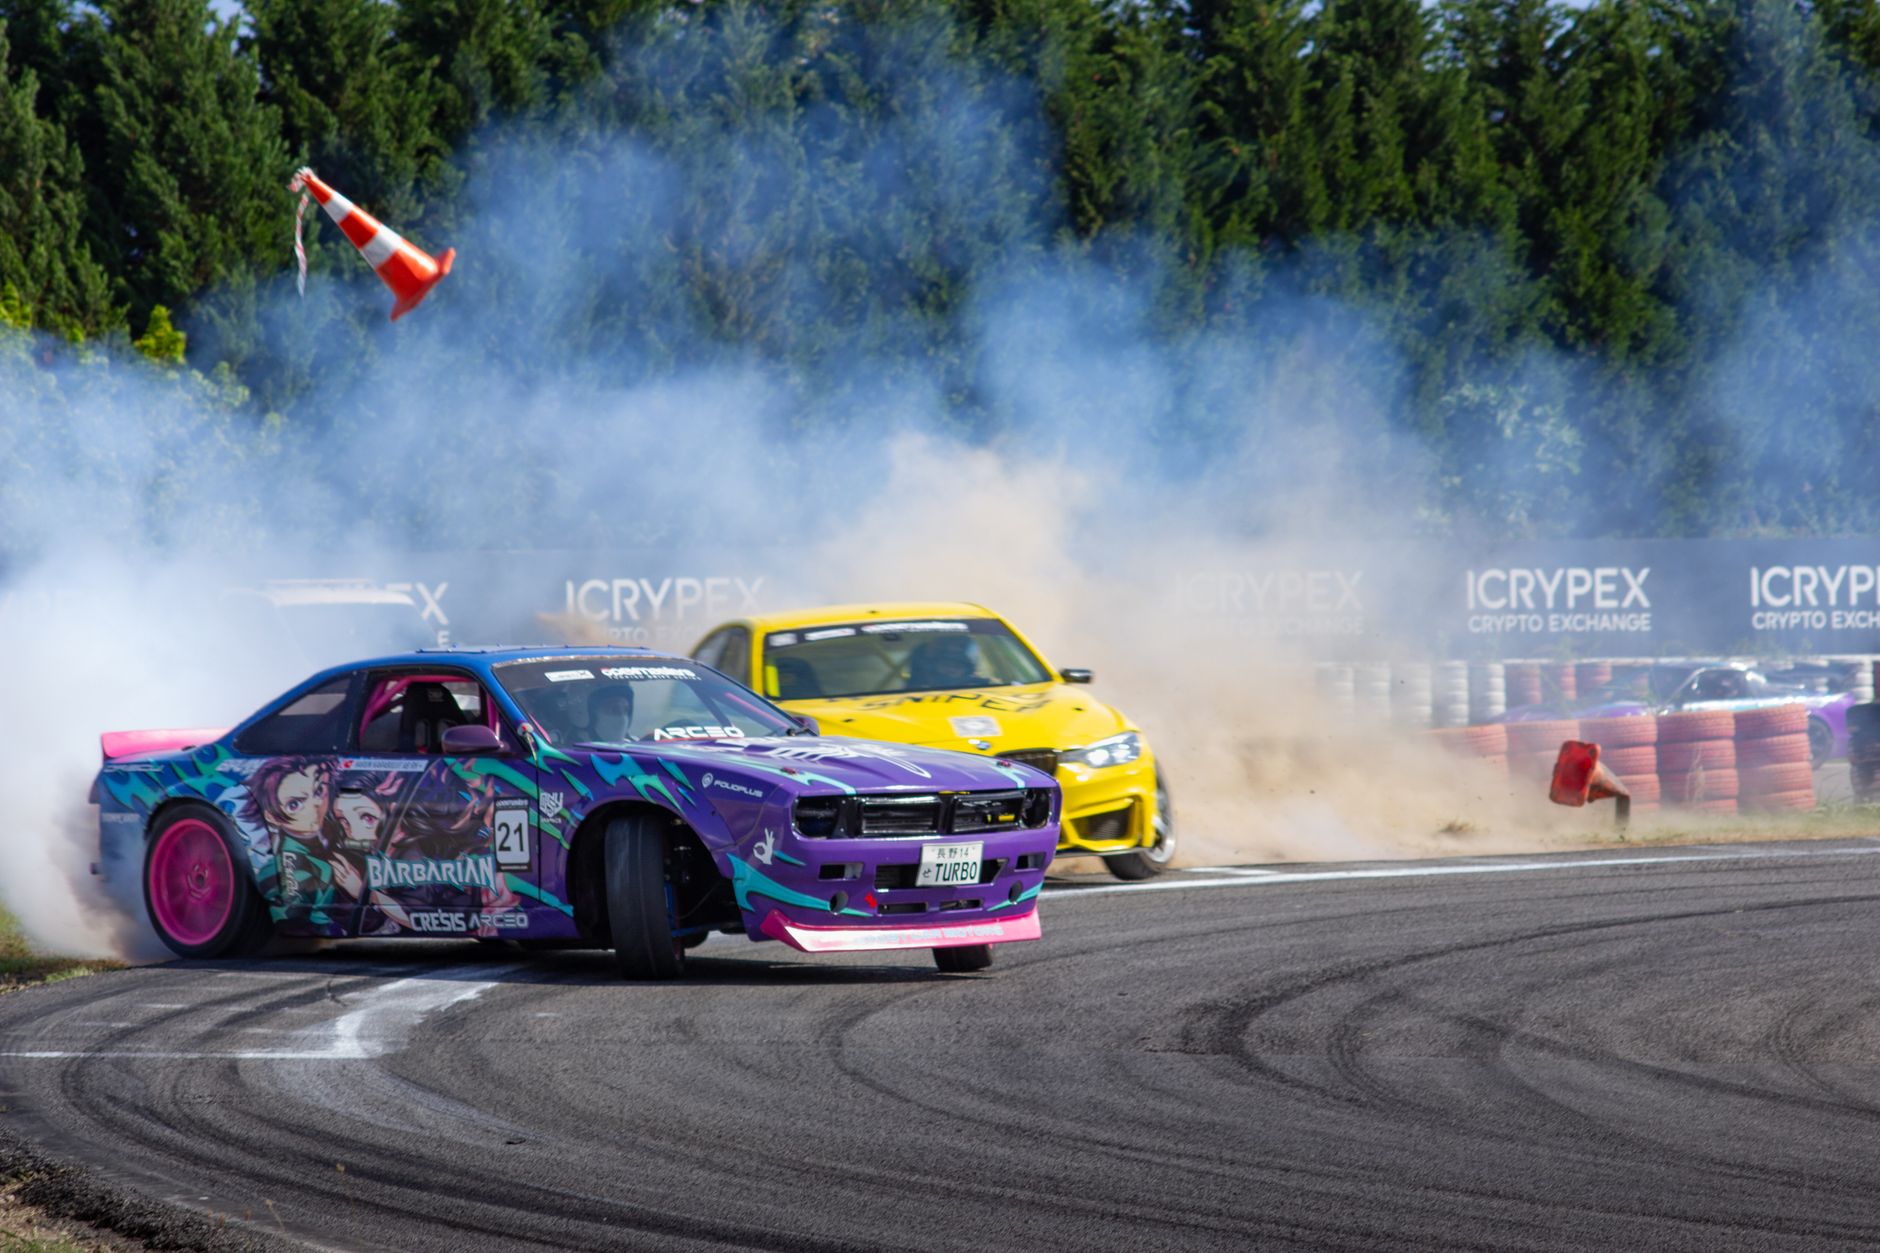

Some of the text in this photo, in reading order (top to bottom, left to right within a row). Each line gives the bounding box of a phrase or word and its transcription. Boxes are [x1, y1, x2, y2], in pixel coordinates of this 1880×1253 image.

[1466, 567, 1651, 610] ICRYPEX
[1750, 565, 1880, 607] ICRYP
[1467, 612, 1653, 633] CRYPTO EXCHANGE
[1751, 610, 1828, 630] CRYPTO
[497, 821, 524, 852] 21
[366, 854, 499, 896] BARBARIAN
[934, 861, 978, 882] TURBO
